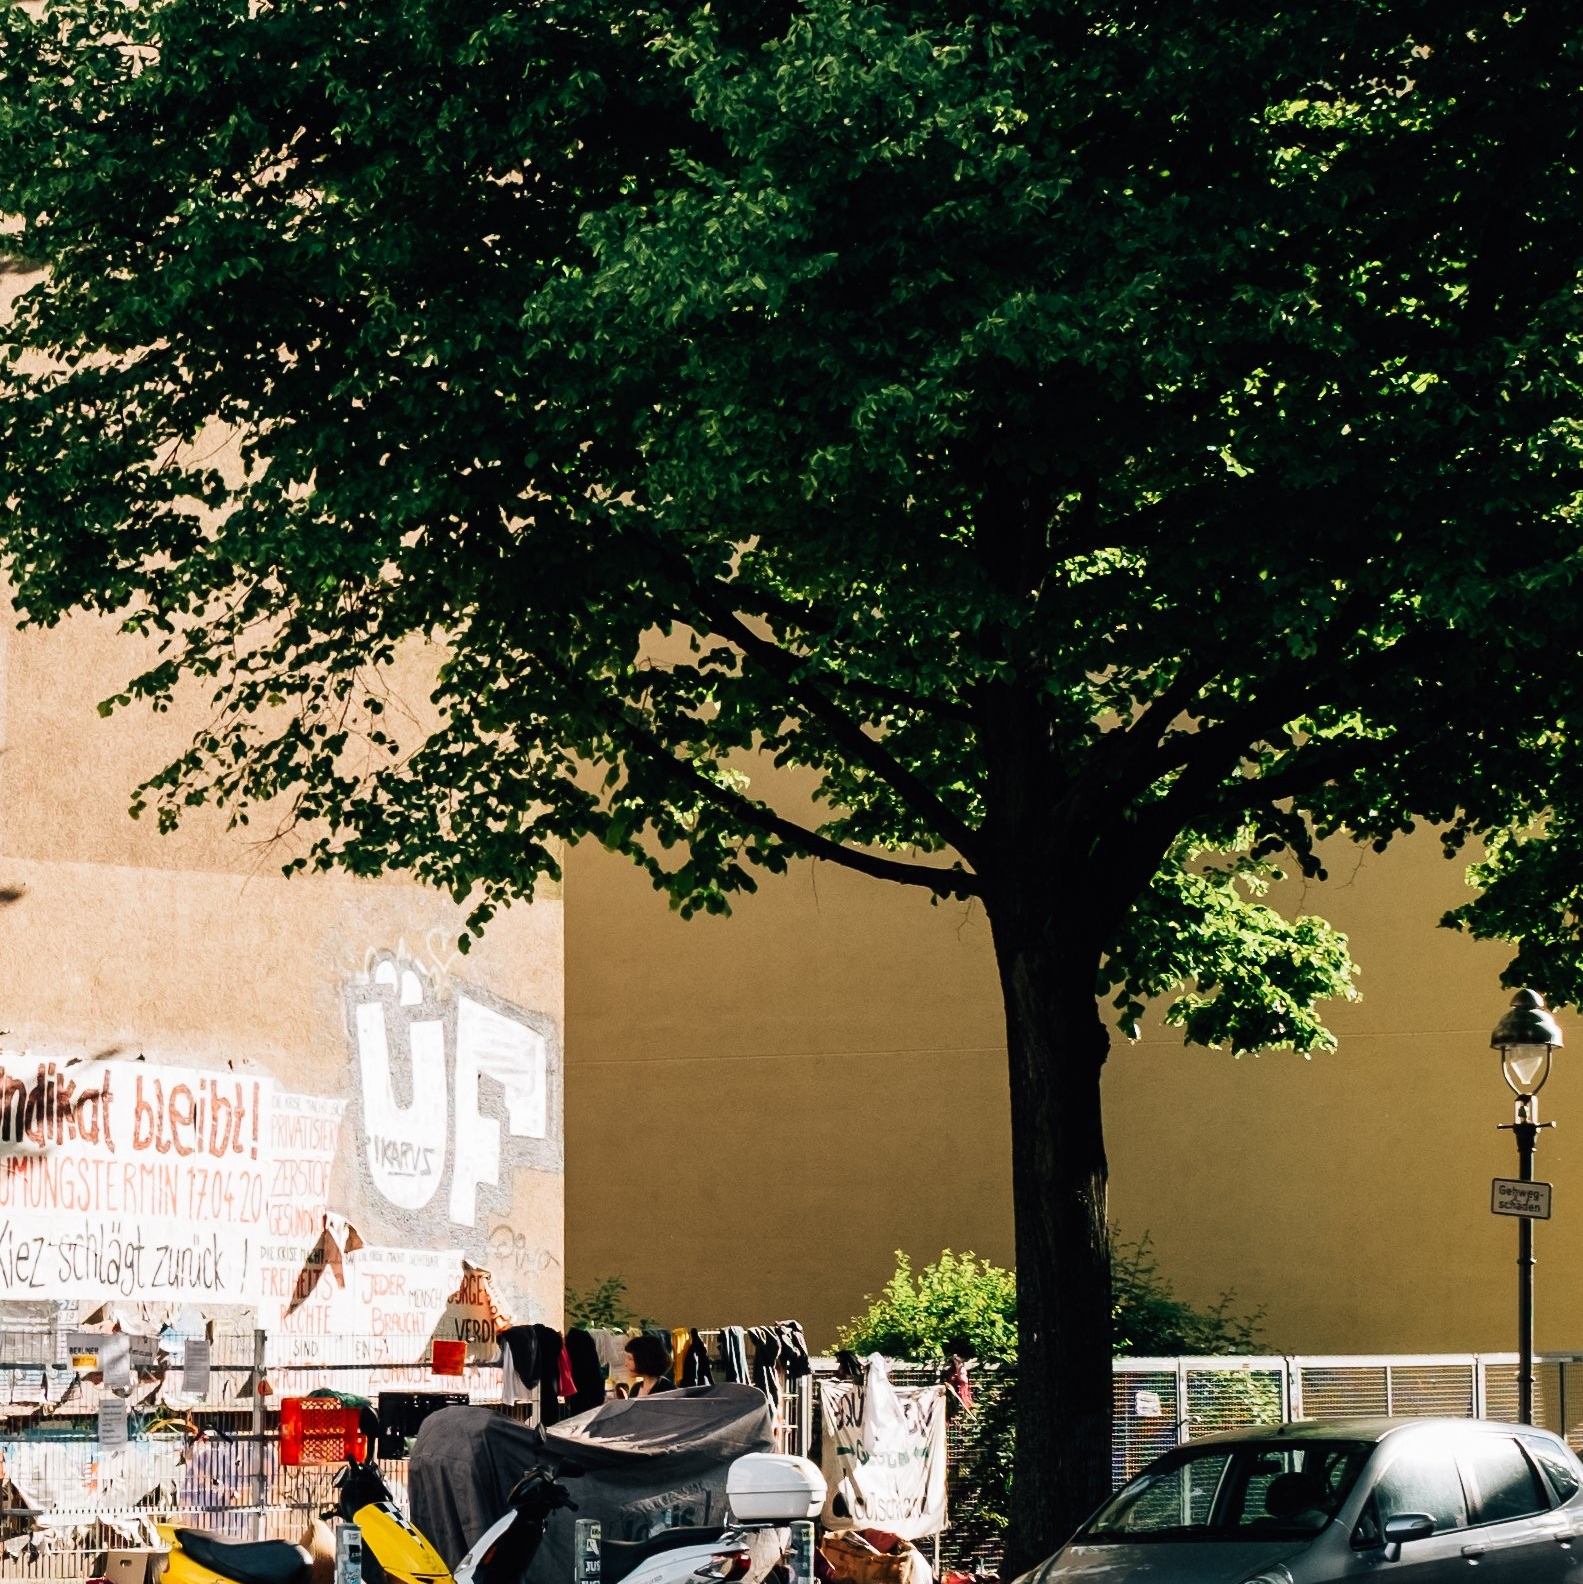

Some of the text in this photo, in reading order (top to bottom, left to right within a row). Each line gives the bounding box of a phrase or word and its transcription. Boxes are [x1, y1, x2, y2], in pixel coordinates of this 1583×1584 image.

[132, 1074, 261, 1160] bleibt!
[56, 1216, 146, 1297] schlägt
[151, 1233, 226, 1293] zurück
